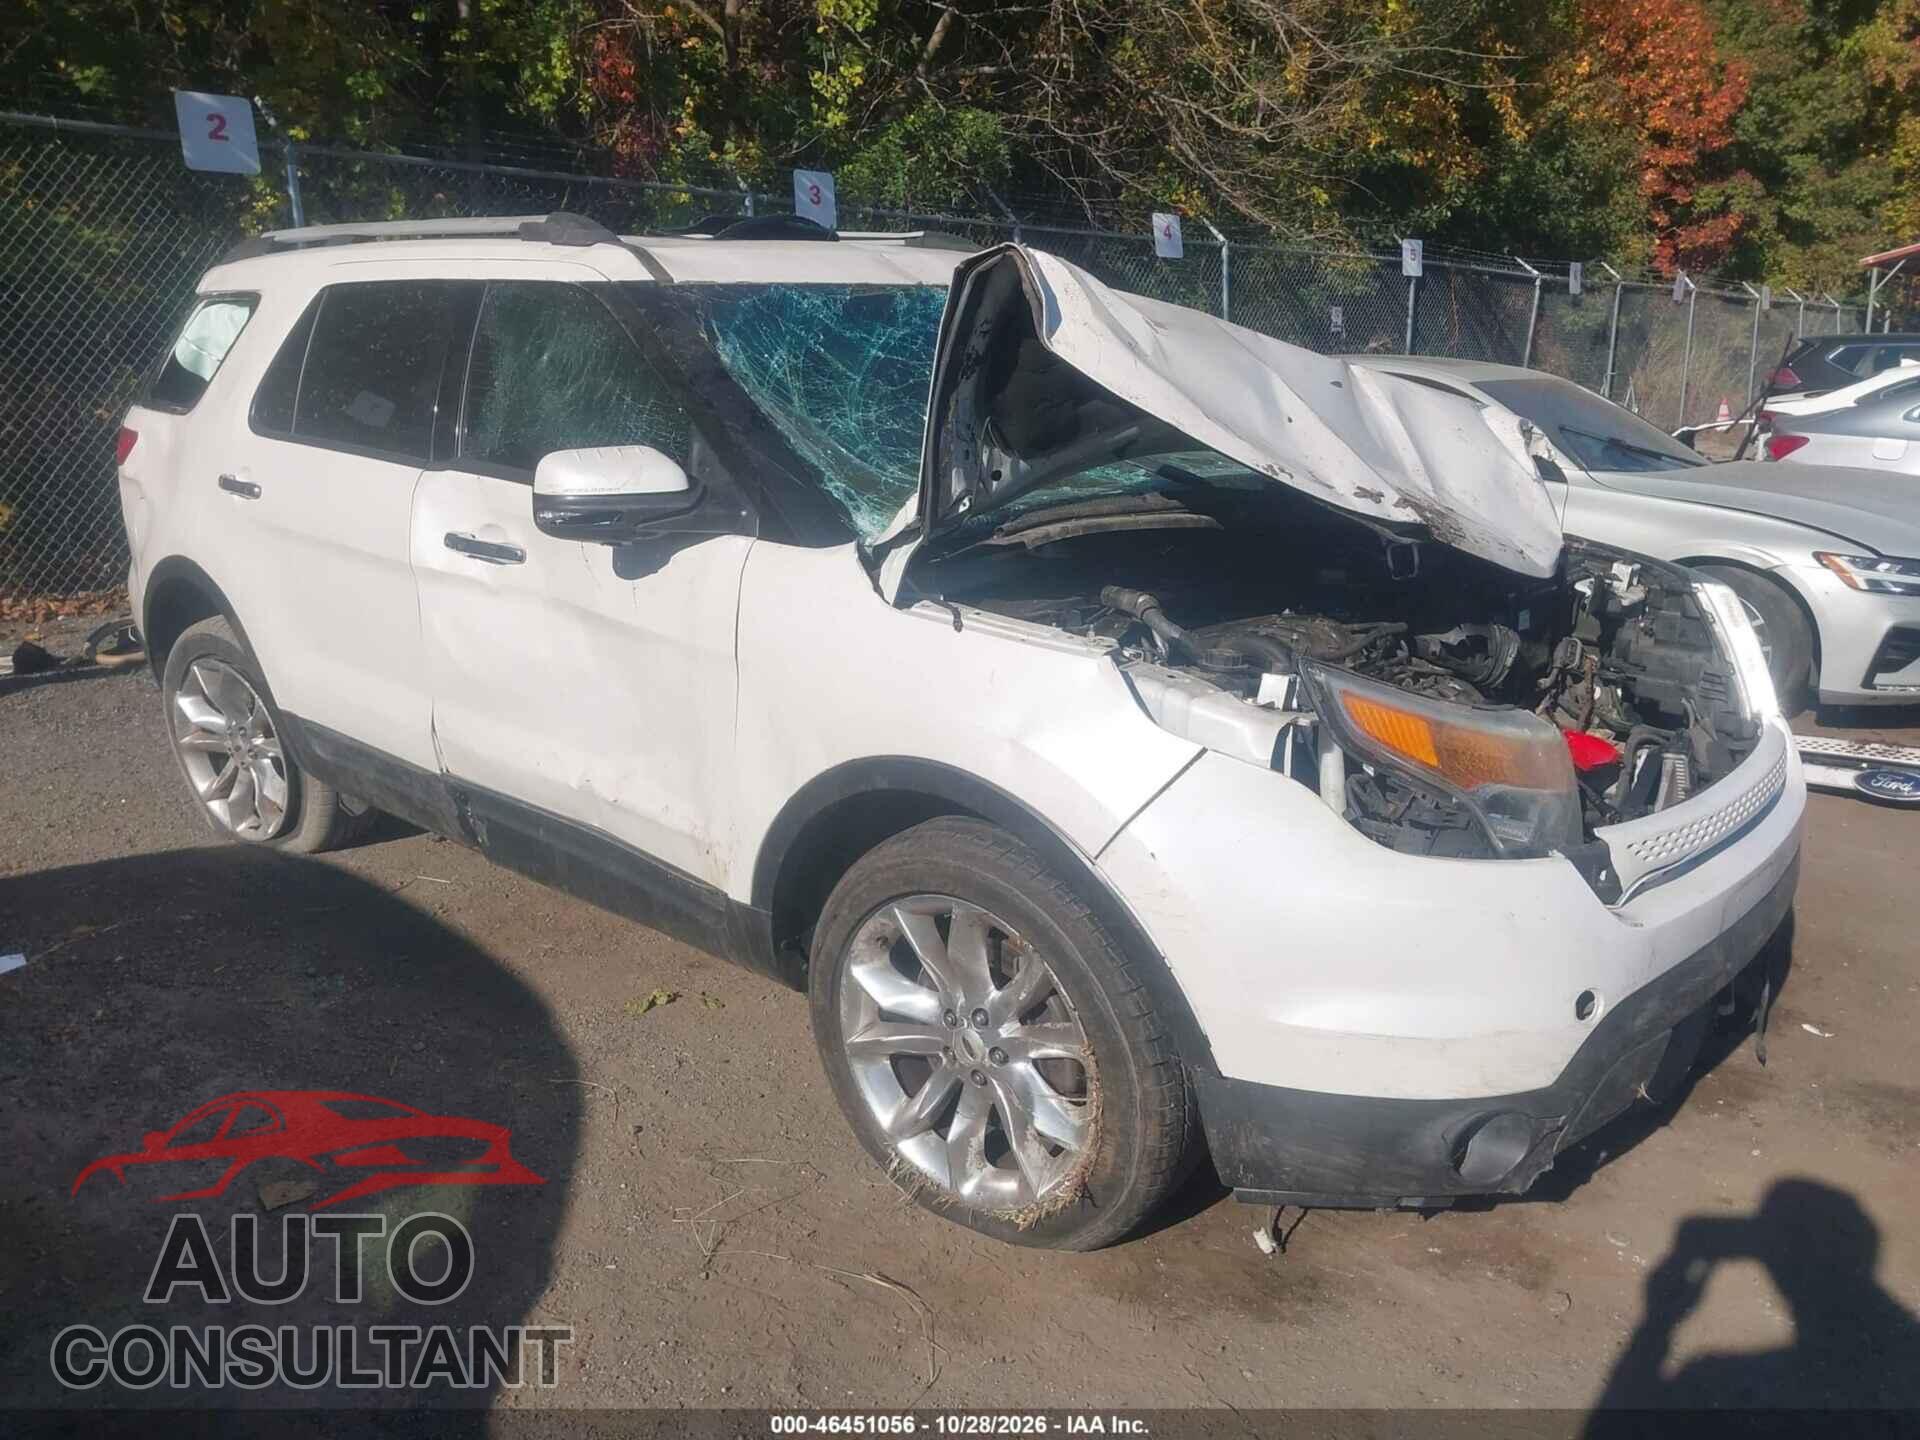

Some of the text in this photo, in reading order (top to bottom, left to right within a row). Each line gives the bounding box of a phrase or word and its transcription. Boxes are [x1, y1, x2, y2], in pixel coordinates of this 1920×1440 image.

[206, 113, 229, 142] 2
[809, 184, 821, 205] 3
[1163, 224, 1172, 240] 4
[1871, 774, 1914, 793] Ford
